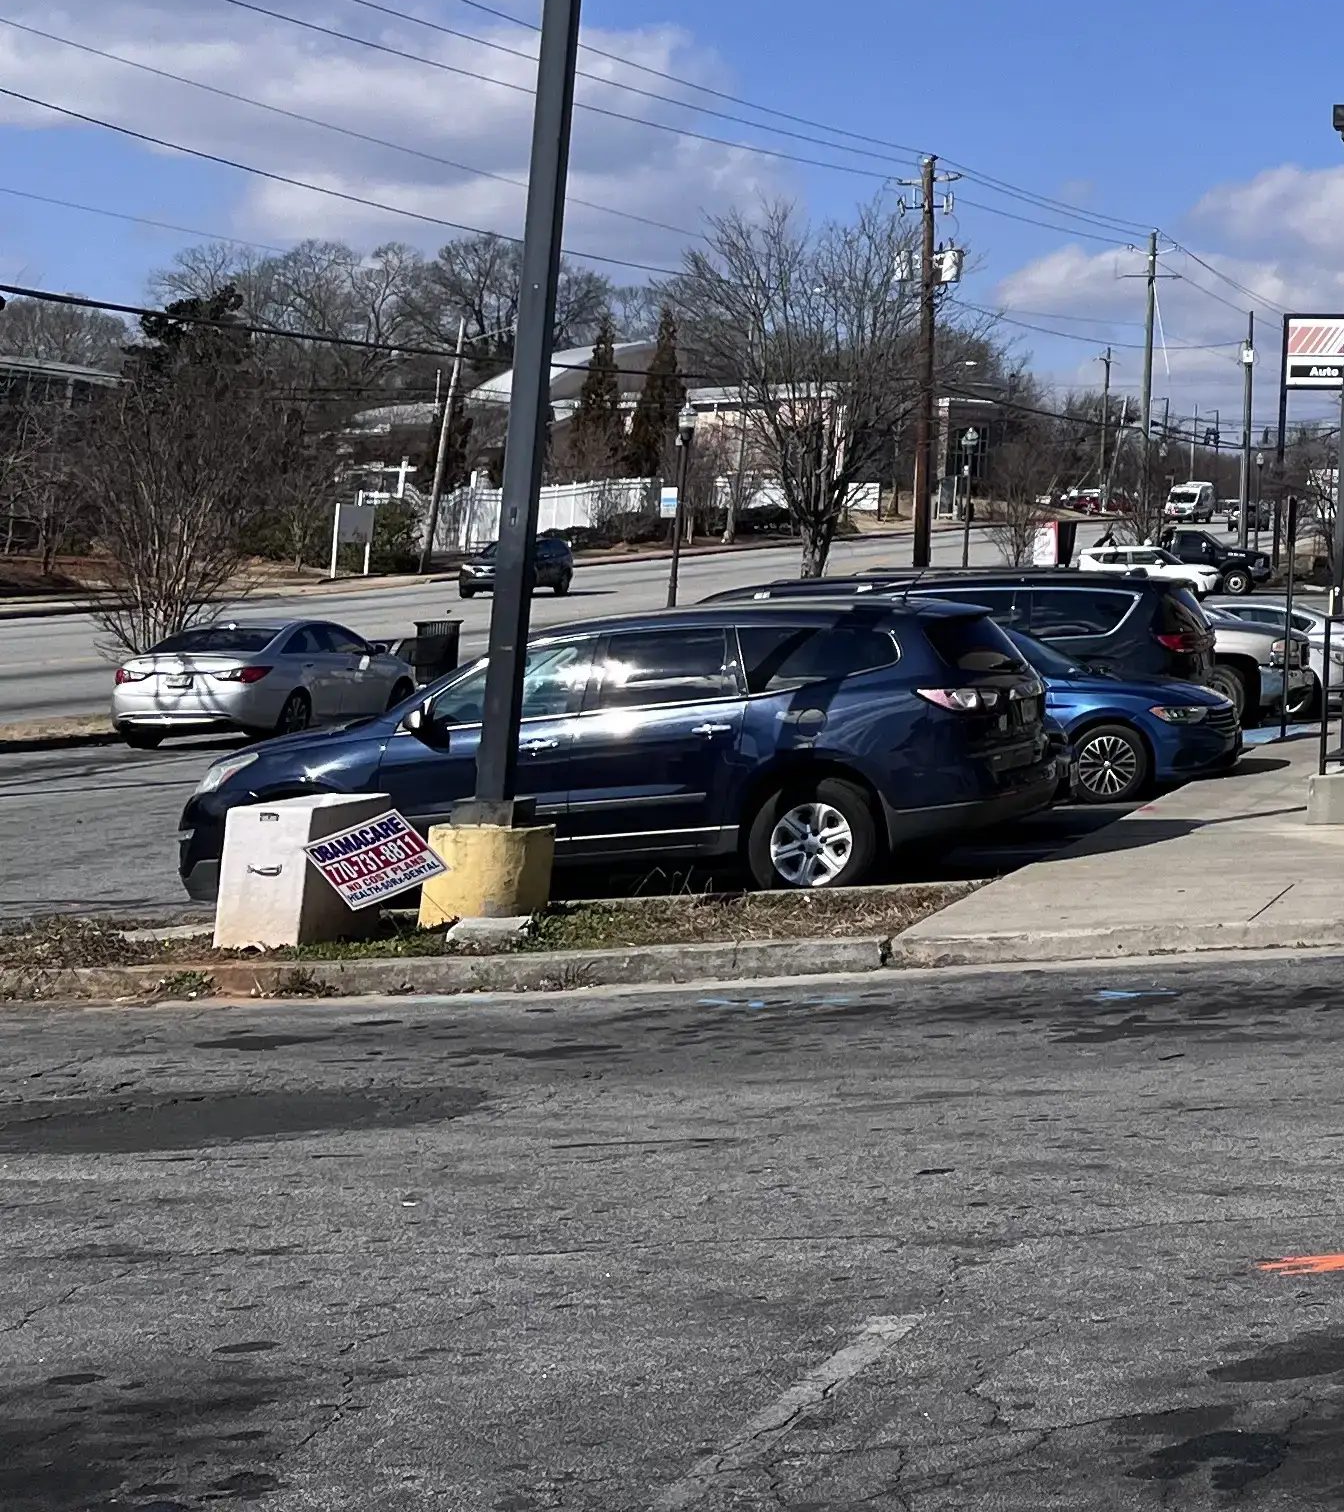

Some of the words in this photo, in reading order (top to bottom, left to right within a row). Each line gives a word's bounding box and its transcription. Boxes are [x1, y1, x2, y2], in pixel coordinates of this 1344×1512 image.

[1309, 366, 1339, 377] Auto
[310, 816, 406, 864] OBAMACARE
[325, 834, 421, 884] 770-731-8811
[346, 881, 361, 892] NO
[363, 871, 389, 886] COST
[392, 855, 427, 875] PLANS
